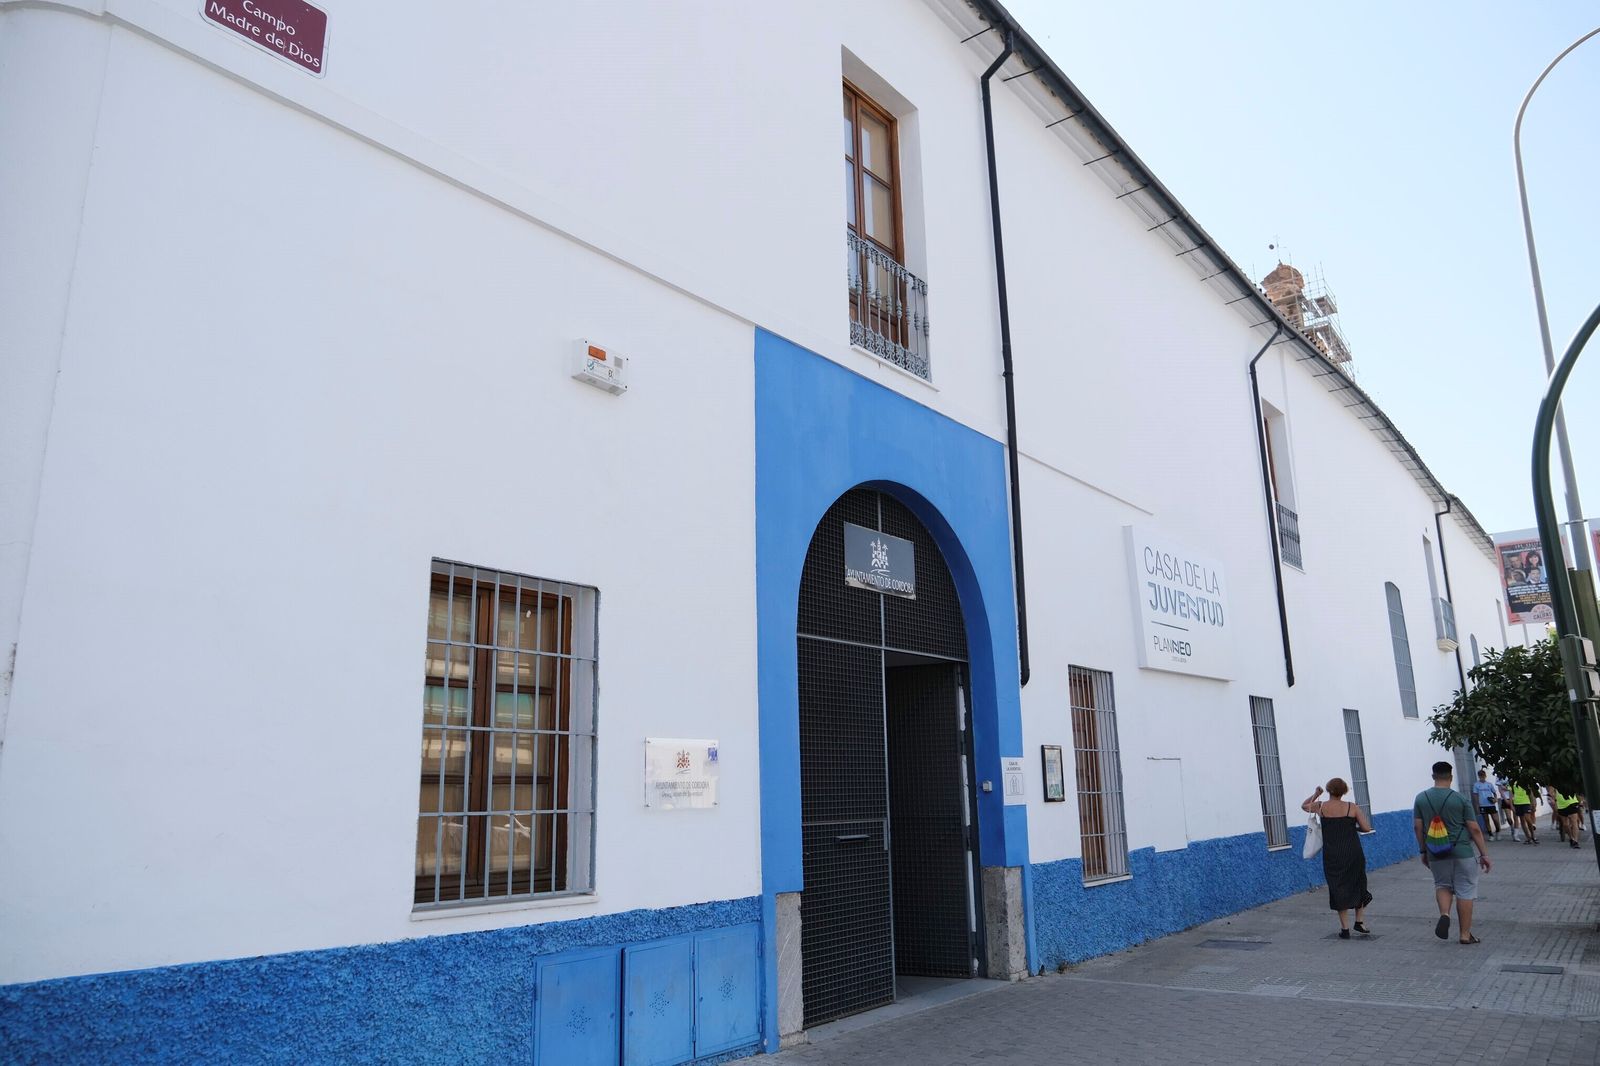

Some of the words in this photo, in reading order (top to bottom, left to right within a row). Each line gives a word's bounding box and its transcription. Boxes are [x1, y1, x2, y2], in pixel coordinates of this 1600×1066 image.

[210, 2, 261, 37] Madre
[265, 32, 284, 49] de
[288, 42, 320, 68] Dios
[243, 0, 295, 36] Campo
[846, 568, 885, 587] AYUNTAMIENTO
[885, 577, 891, 589] DE
[1144, 546, 1183, 584] CASA
[1184, 560, 1202, 590] DE
[1203, 567, 1220, 597] LA
[1147, 581, 1224, 628] JUVENTUD
